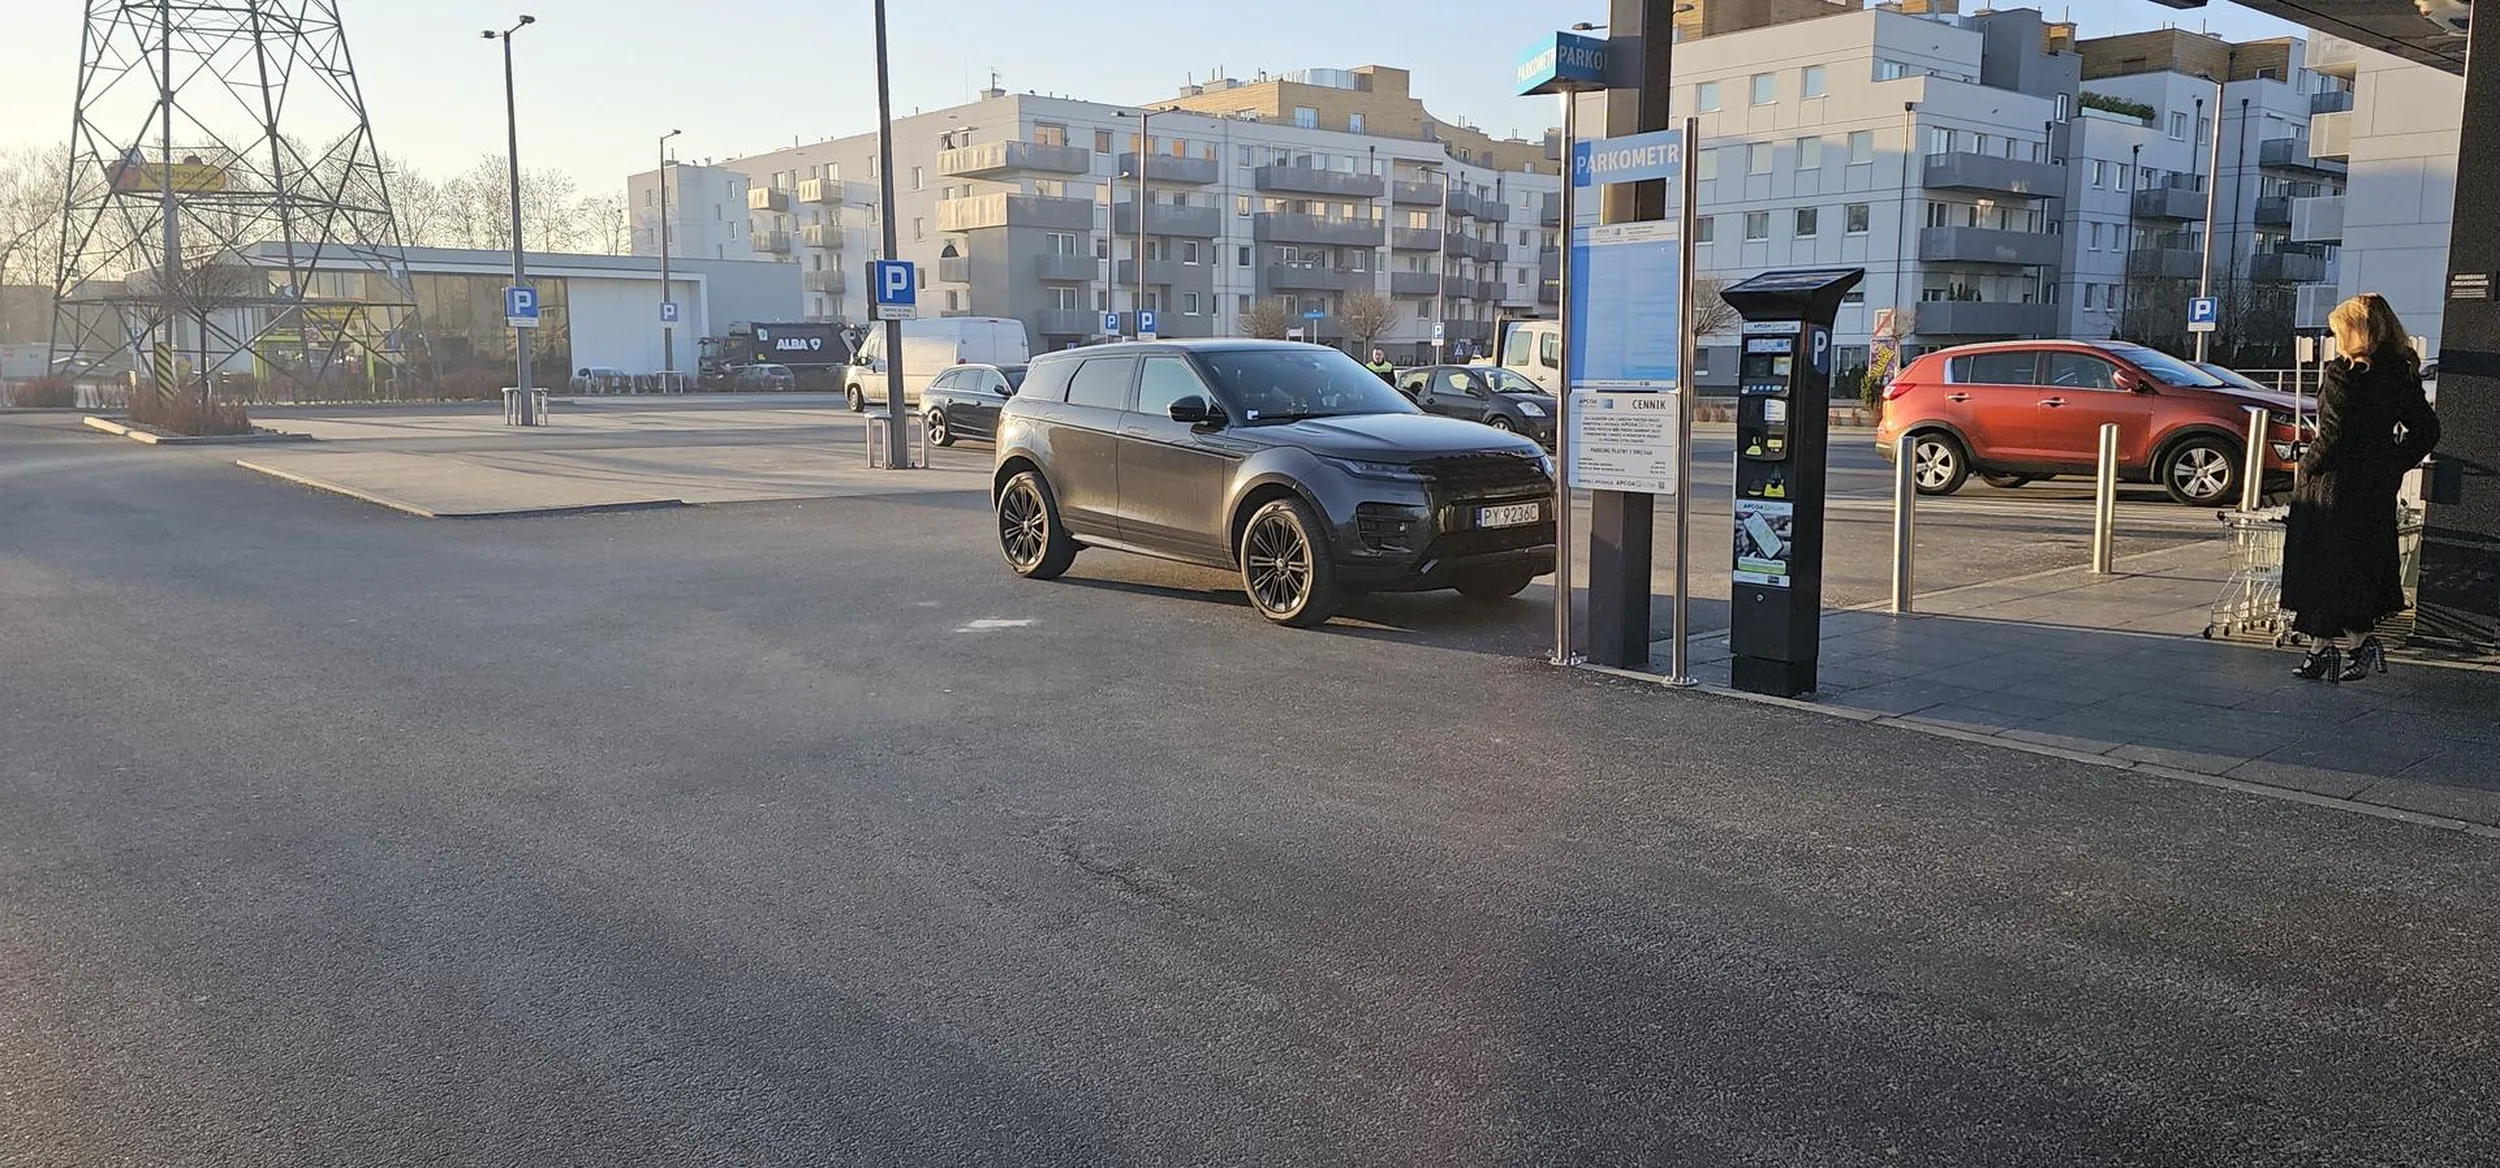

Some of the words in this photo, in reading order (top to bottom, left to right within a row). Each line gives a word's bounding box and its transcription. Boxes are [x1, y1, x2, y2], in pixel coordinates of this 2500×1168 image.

[1558, 44, 1607, 72] PARKO
[1576, 144, 1679, 174] PARKOMETR
[885, 265, 907, 299] P
[514, 291, 532, 314] P
[664, 304, 675, 319] P
[2194, 300, 2211, 320] P
[1107, 315, 1115, 328] P
[1142, 312, 1152, 330] P
[1434, 325, 1442, 338] P
[776, 338, 808, 350] ALBA
[1813, 331, 1828, 366] P
[1632, 399, 1666, 410] CENNIK
[1484, 507, 1498, 525] PY
[1503, 505, 1537, 523] 9236C
